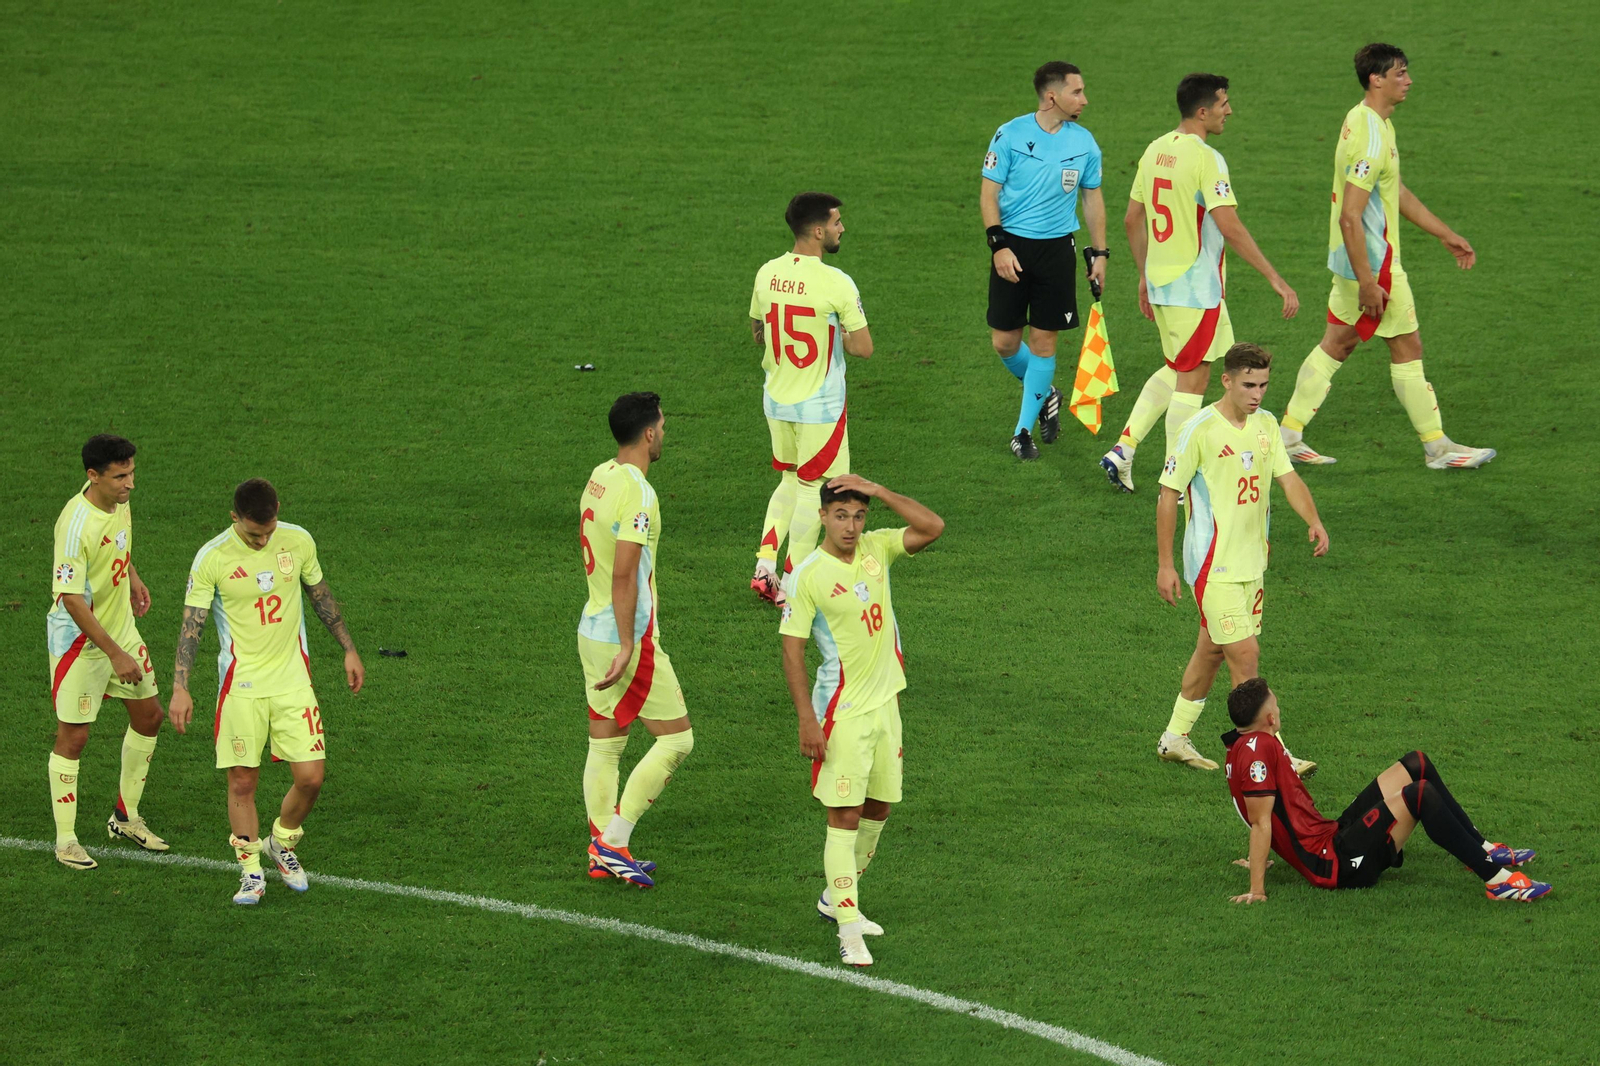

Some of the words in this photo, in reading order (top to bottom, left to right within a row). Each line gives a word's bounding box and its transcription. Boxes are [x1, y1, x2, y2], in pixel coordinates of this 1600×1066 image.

[1152, 177, 1174, 243] 5
[770, 274, 795, 294] ÁLEX
[797, 281, 808, 295] B.
[765, 302, 819, 369] 15
[1237, 475, 1260, 505] 25
[254, 594, 282, 626] 12
[860, 603, 883, 637] 18
[302, 706, 324, 736] 12
